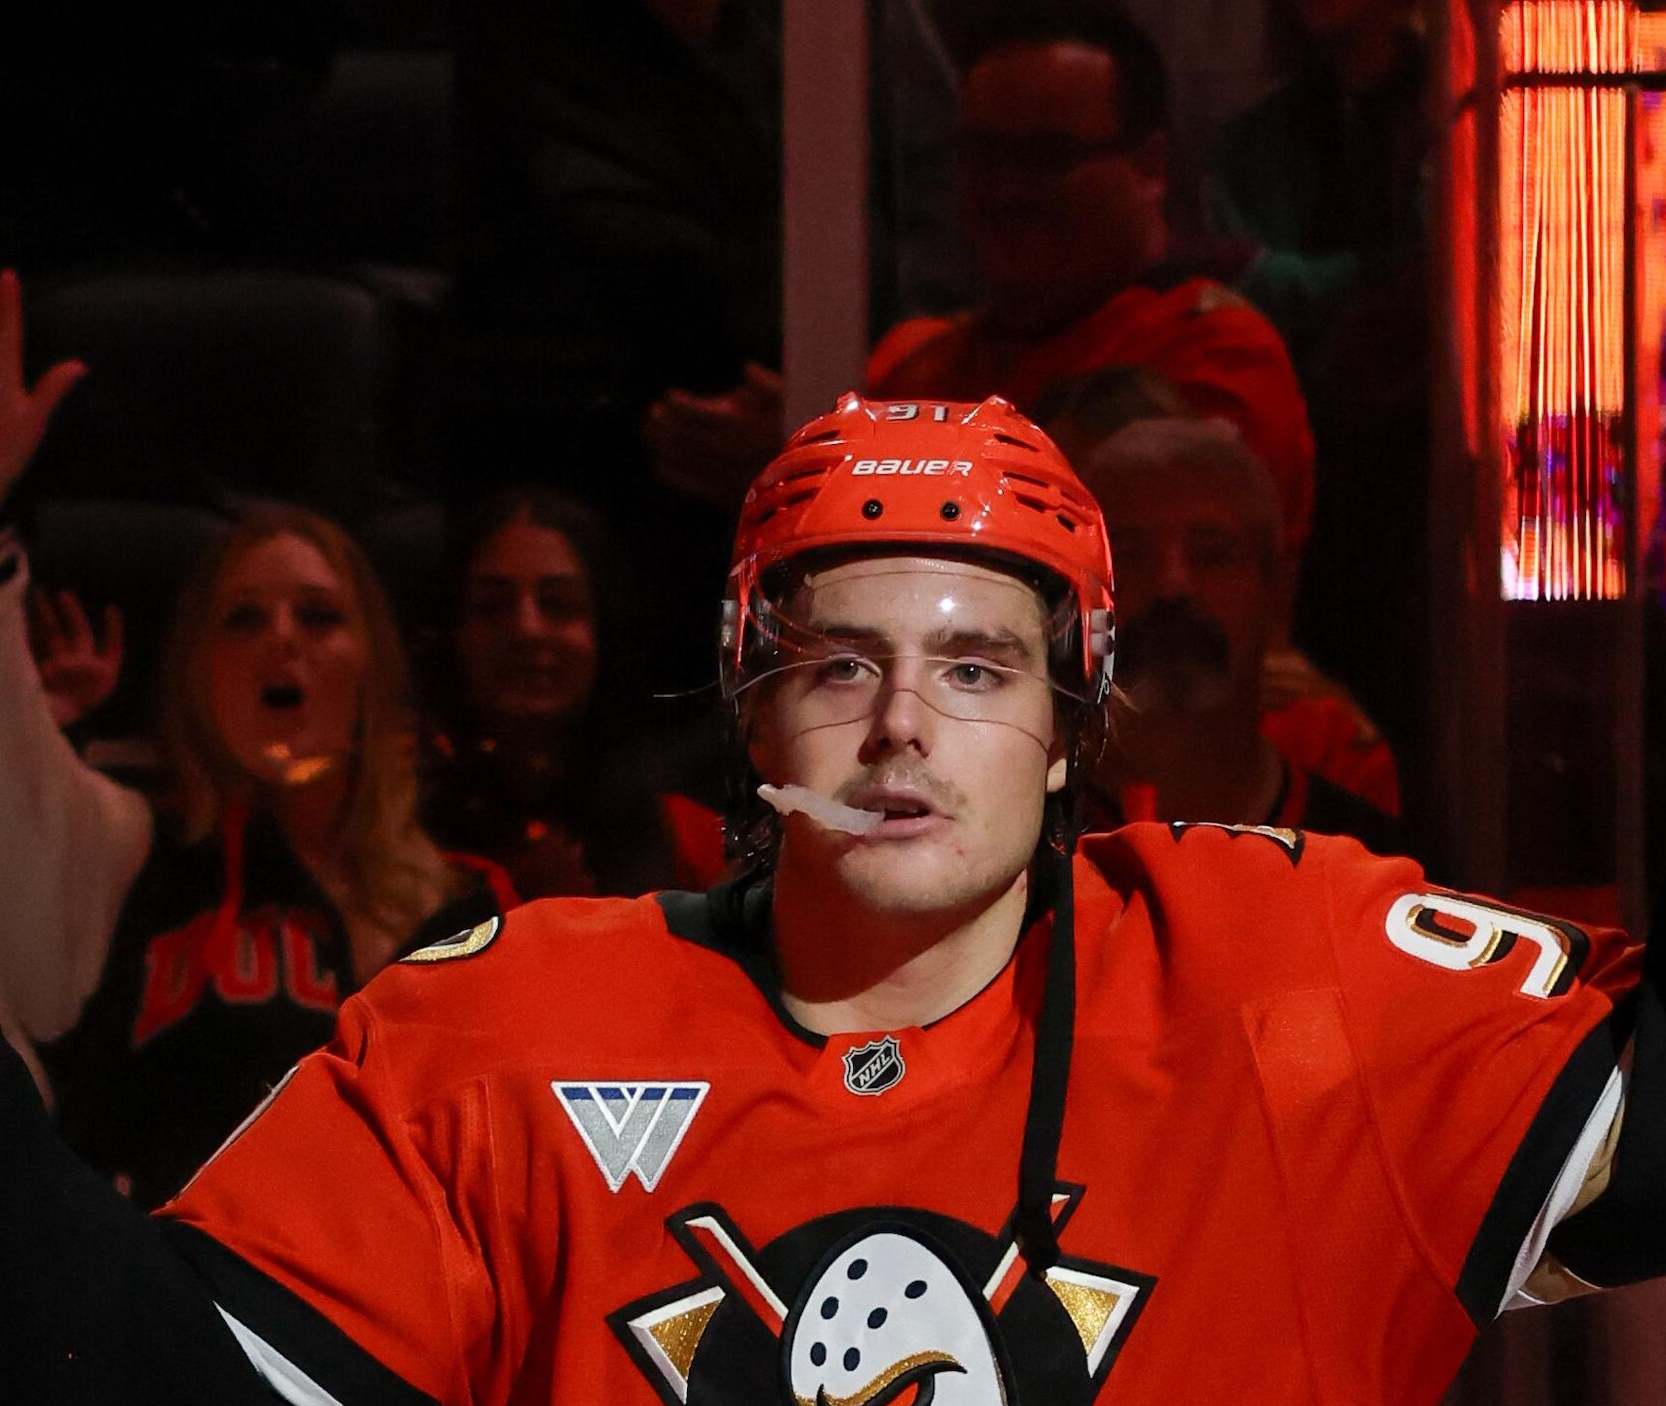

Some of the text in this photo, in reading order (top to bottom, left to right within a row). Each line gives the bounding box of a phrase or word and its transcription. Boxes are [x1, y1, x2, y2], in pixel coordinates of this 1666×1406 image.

[886, 404, 949, 422] 91
[132, 905, 339, 1046] DUC
[858, 1052, 891, 1087] NHL
